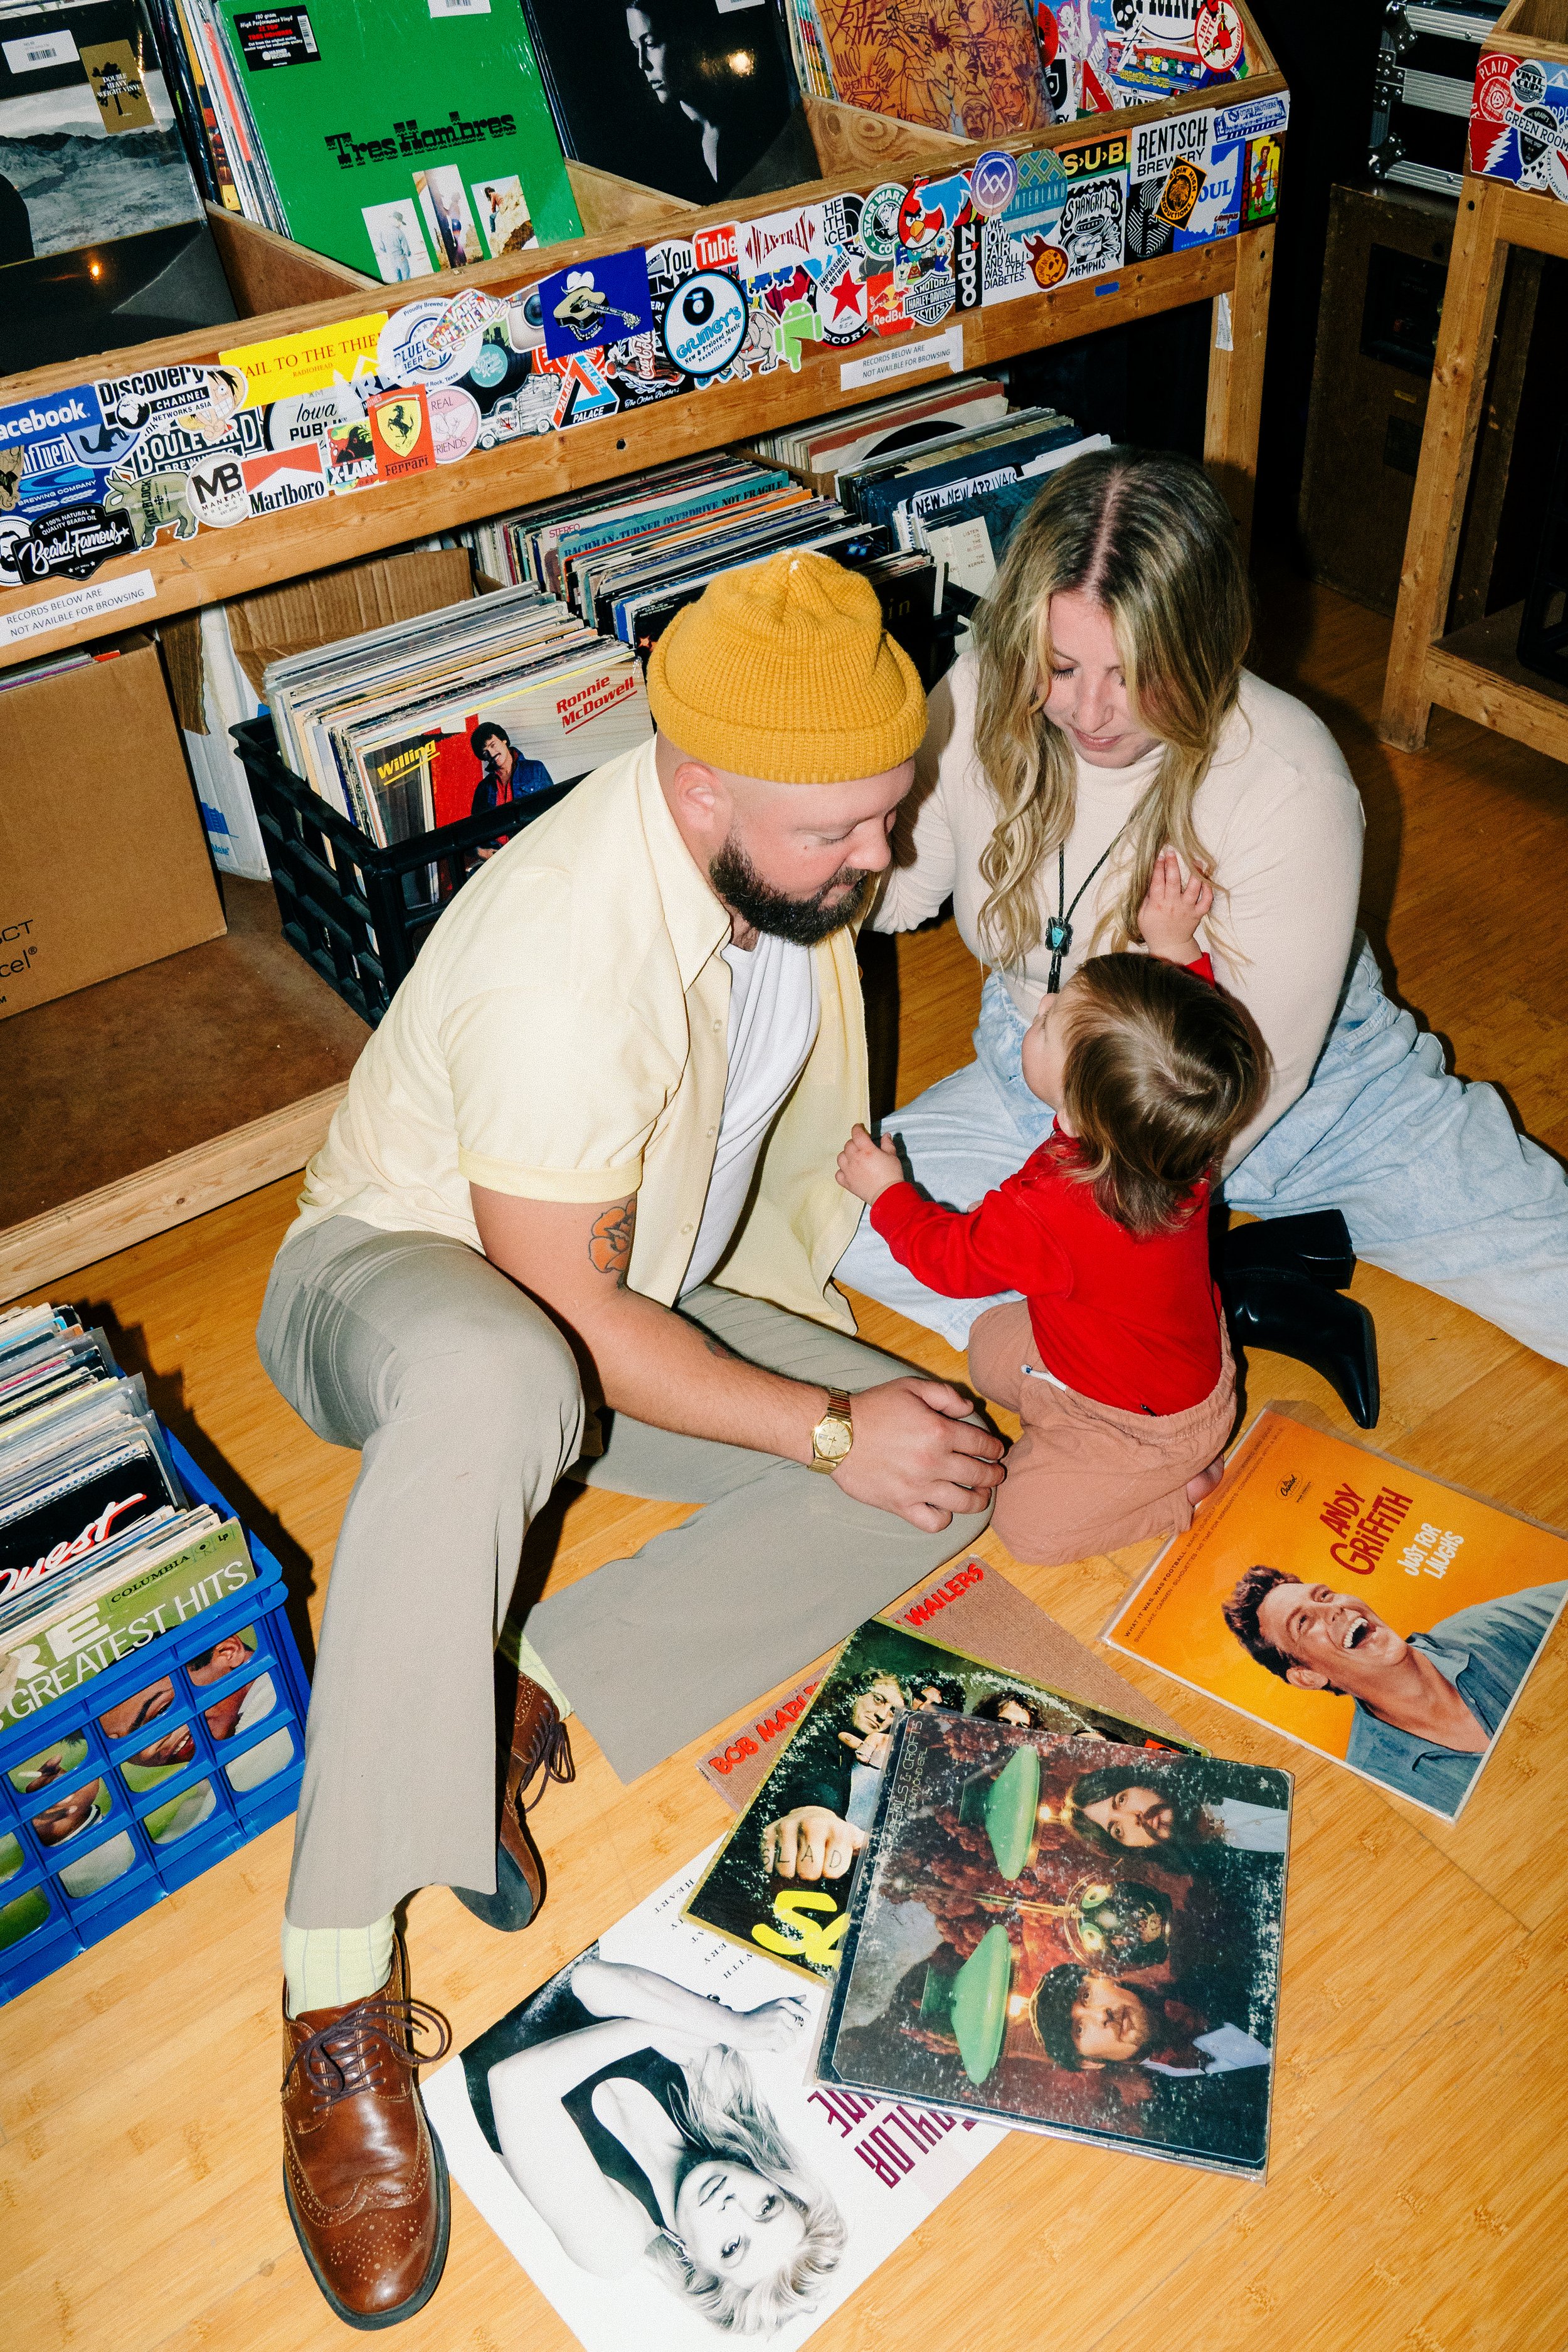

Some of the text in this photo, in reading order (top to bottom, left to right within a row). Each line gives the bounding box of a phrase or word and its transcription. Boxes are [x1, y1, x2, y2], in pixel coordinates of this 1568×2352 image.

[253, 18, 280, 27] Performance
[102, 73, 127, 83] DOUBLE
[1479, 60, 1508, 80] PLAID
[1515, 68, 1545, 85] VINYL
[97, 84, 141, 98] WEIGHT VINYL
[1254, 102, 1276, 112] BROTHERS
[1505, 110, 1539, 135] GREEN
[324, 111, 517, 169] Tres Hombres
[1137, 116, 1209, 163] RENTSCH
[863, 190, 905, 238] STAR WARS
[1161, 190, 1192, 221] PRODUCTIONS
[661, 247, 692, 274] You
[697, 234, 738, 266] Tube
[985, 242, 1010, 260] FAIR
[985, 255, 1021, 268] AND ALL
[819, 252, 848, 289] IMPOSSIBLE
[823, 257, 852, 293] IS NOTHING!
[984, 271, 1027, 291] DIABETES.
[985, 262, 1027, 280] WAS TYPE
[1067, 258, 1106, 279] MEMPHIS
[908, 285, 956, 310] HARLEY-DAVIDSON
[919, 279, 947, 294] MOTOR
[403, 304, 423, 316] Proudly
[449, 299, 479, 322] VANS
[921, 302, 948, 320] CYCLES
[676, 306, 742, 359] GRIMEY'S
[684, 322, 741, 365] New Preloved Music
[723, 337, 733, 346] TN
[272, 333, 381, 370] TO THE THIE
[862, 344, 925, 368] RECORDS BELOW ARE
[862, 349, 951, 378] NOT AVAILBLE FOR BROWSING
[292, 362, 334, 378] RADIOHEAD
[445, 372, 459, 383] Texas
[581, 362, 607, 390] PALACE
[97, 366, 204, 407] Discovery
[156, 389, 206, 410] CHANNEL
[556, 376, 575, 412] PALACE
[624, 386, 680, 408] The Other Brothers
[152, 401, 212, 422] NETWORKS ASIA
[296, 403, 337, 423] Iowa
[431, 396, 454, 411] REAL
[572, 406, 605, 424] PALACE
[384, 455, 429, 477] Ferrari
[18, 479, 97, 506] BREWING COMPANY
[192, 462, 243, 505] MB
[916, 470, 1018, 517] NEW NEW ARRIVALS
[251, 480, 326, 516] Marlboro
[662, 479, 784, 529] OVERDRIVE NOT FRAGILE
[41, 522, 66, 536] QUALITY
[66, 516, 87, 526] BEARD
[46, 509, 89, 527] 100% NATURAL
[549, 522, 581, 539] STEREO
[963, 528, 980, 538] LISTEN
[967, 544, 983, 553] BLOOD
[968, 559, 987, 568] KERNAL
[6, 587, 103, 625] RECORDS BELOW ARE
[9, 588, 145, 637] NOT AVAILBLE FOR BROWSING
[556, 673, 612, 714] Ronnie
[562, 675, 635, 728] McDowell
[377, 739, 437, 780] Willing
[1280, 1474, 1297, 1496] Capitol
[1319, 1483, 1365, 1539] ANDY
[1397, 1522, 1442, 1576] JUST FOR
[1423, 1530, 1465, 1580] LAUGHS
[110, 1554, 191, 1604] COLUMBIA
[1124, 1619, 1139, 1638] WHAT
[1152, 1581, 1165, 1596] WAS
[1162, 1550, 1187, 1581] FOOTBALL
[1185, 1532, 1199, 1548] MAKE
[1197, 1507, 1216, 1532] YOURSELF
[1133, 1491, 1239, 1643] SWAN LAKE CARMEN SILHOUETTES NO TIME FOR SERGEANTS
[13, 1559, 249, 1720] GREATEST HITS
[708, 1563, 985, 1775] BOB WAILERS
[889, 1720, 923, 1832] SEALS & CROFTS
[908, 1746, 928, 1809] DIAMOND GIRL
[655, 1878, 695, 1914] HEART
